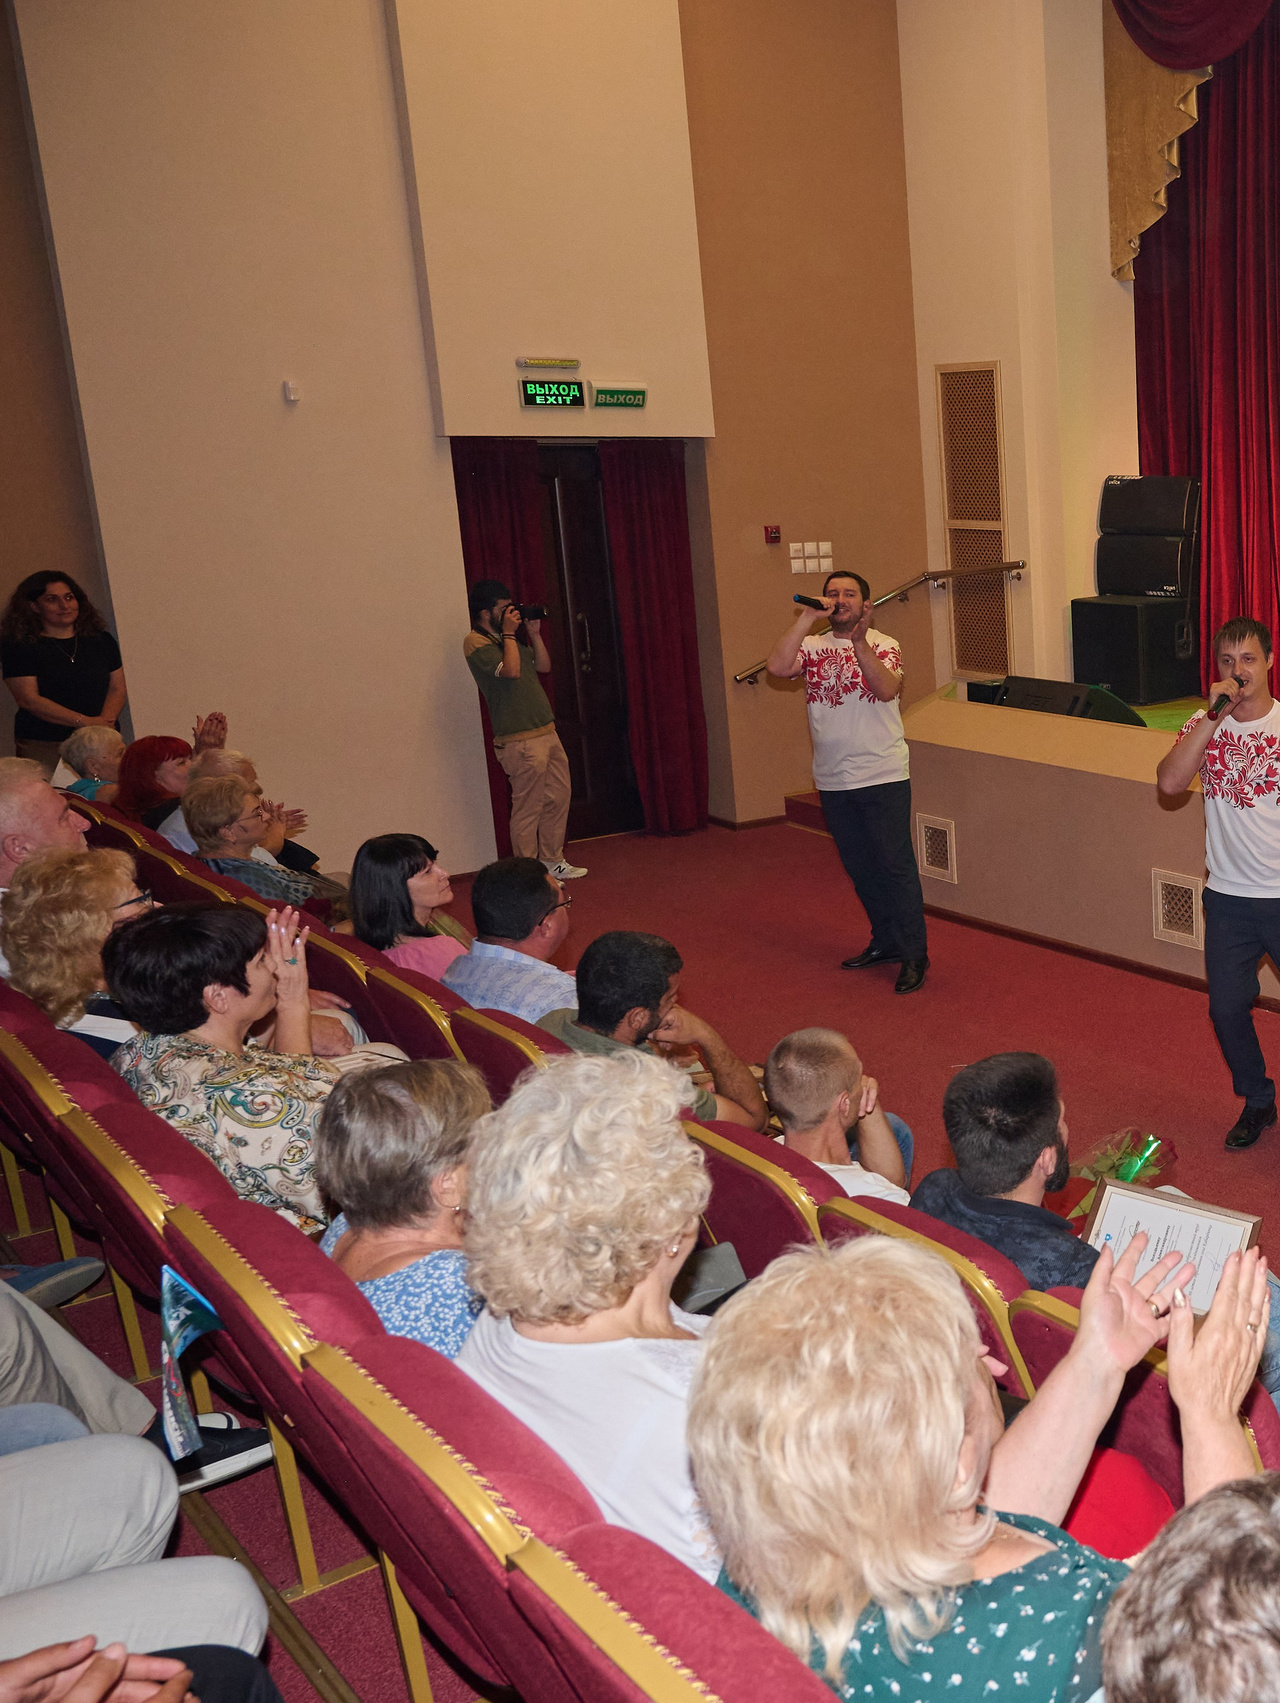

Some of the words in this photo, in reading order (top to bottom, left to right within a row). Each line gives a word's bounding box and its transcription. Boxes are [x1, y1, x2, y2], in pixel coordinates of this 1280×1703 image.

[526, 383, 580, 397] ВЫХОД
[535, 395, 573, 404] EXIT
[597, 394, 644, 405] ВЫХОД
